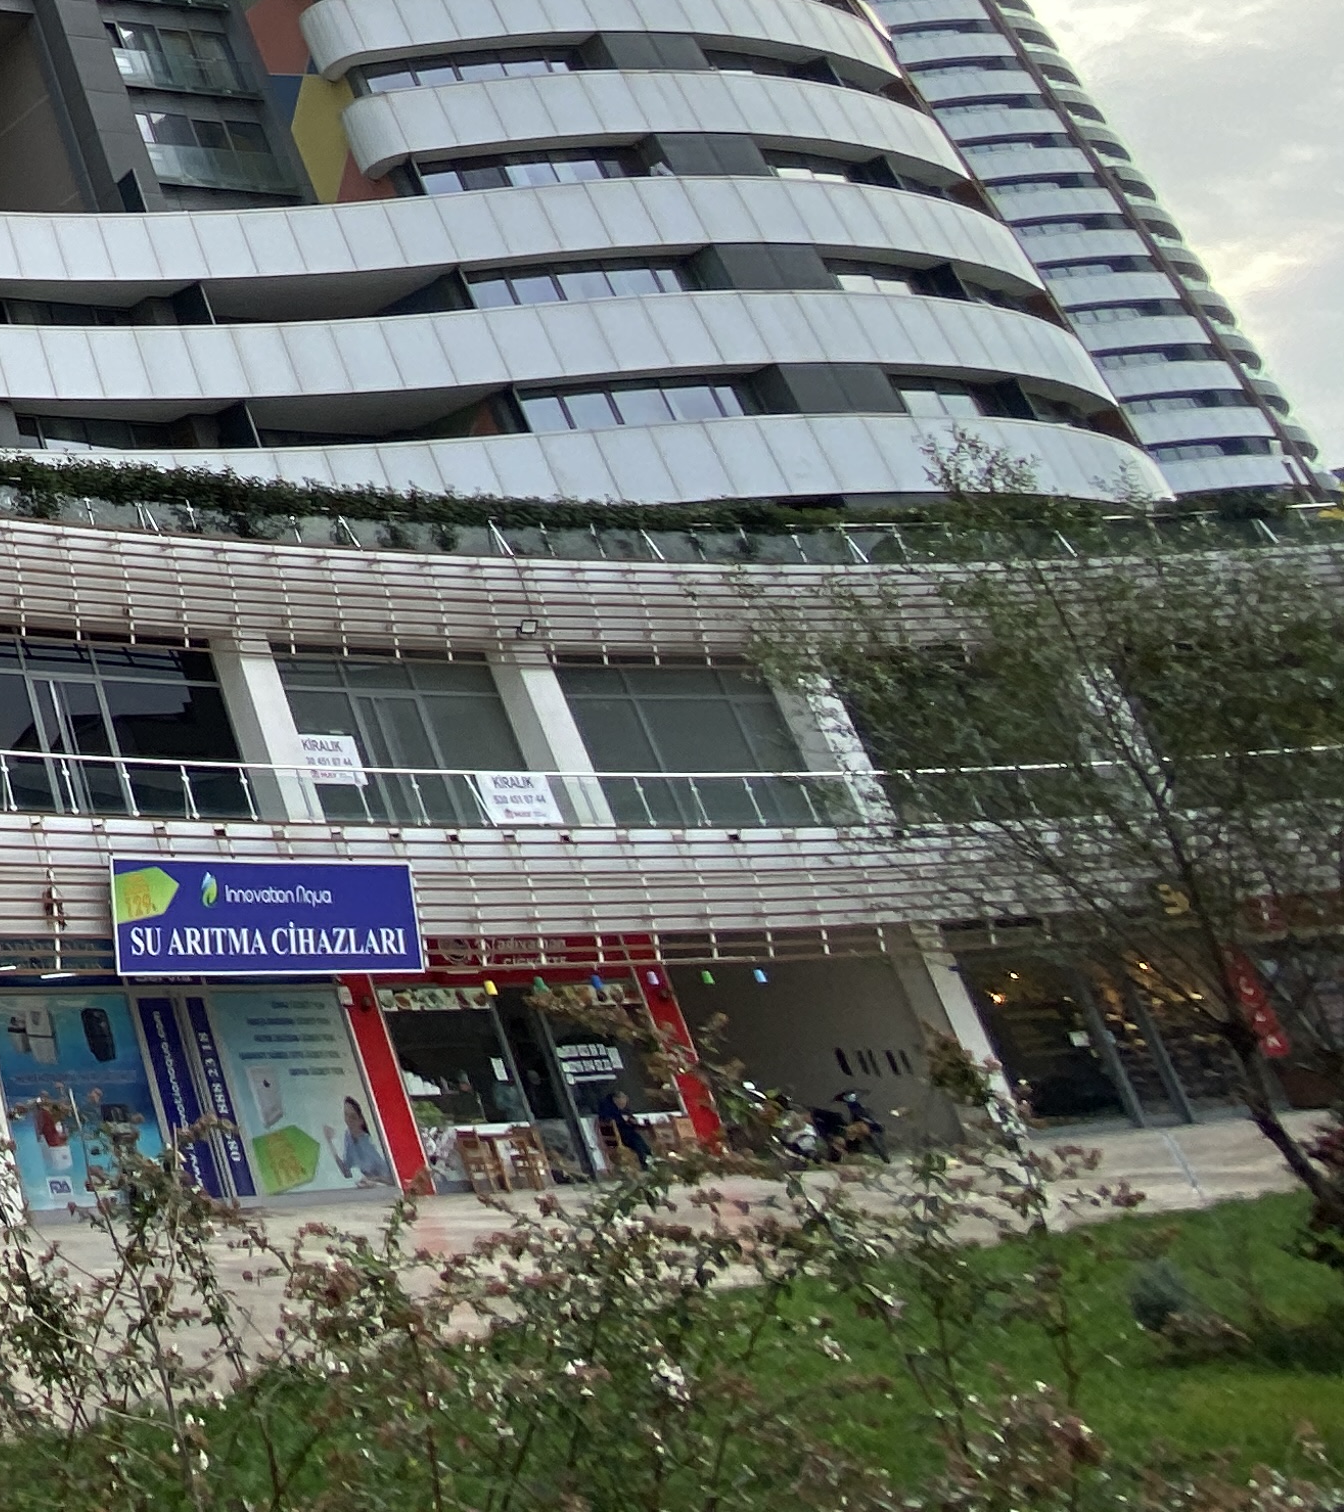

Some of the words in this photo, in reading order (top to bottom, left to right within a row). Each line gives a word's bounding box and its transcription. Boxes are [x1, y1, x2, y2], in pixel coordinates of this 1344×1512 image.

[130, 927, 161, 956] SU
[167, 927, 269, 956] ARITMA
[271, 921, 407, 956] CİHAZLARI
